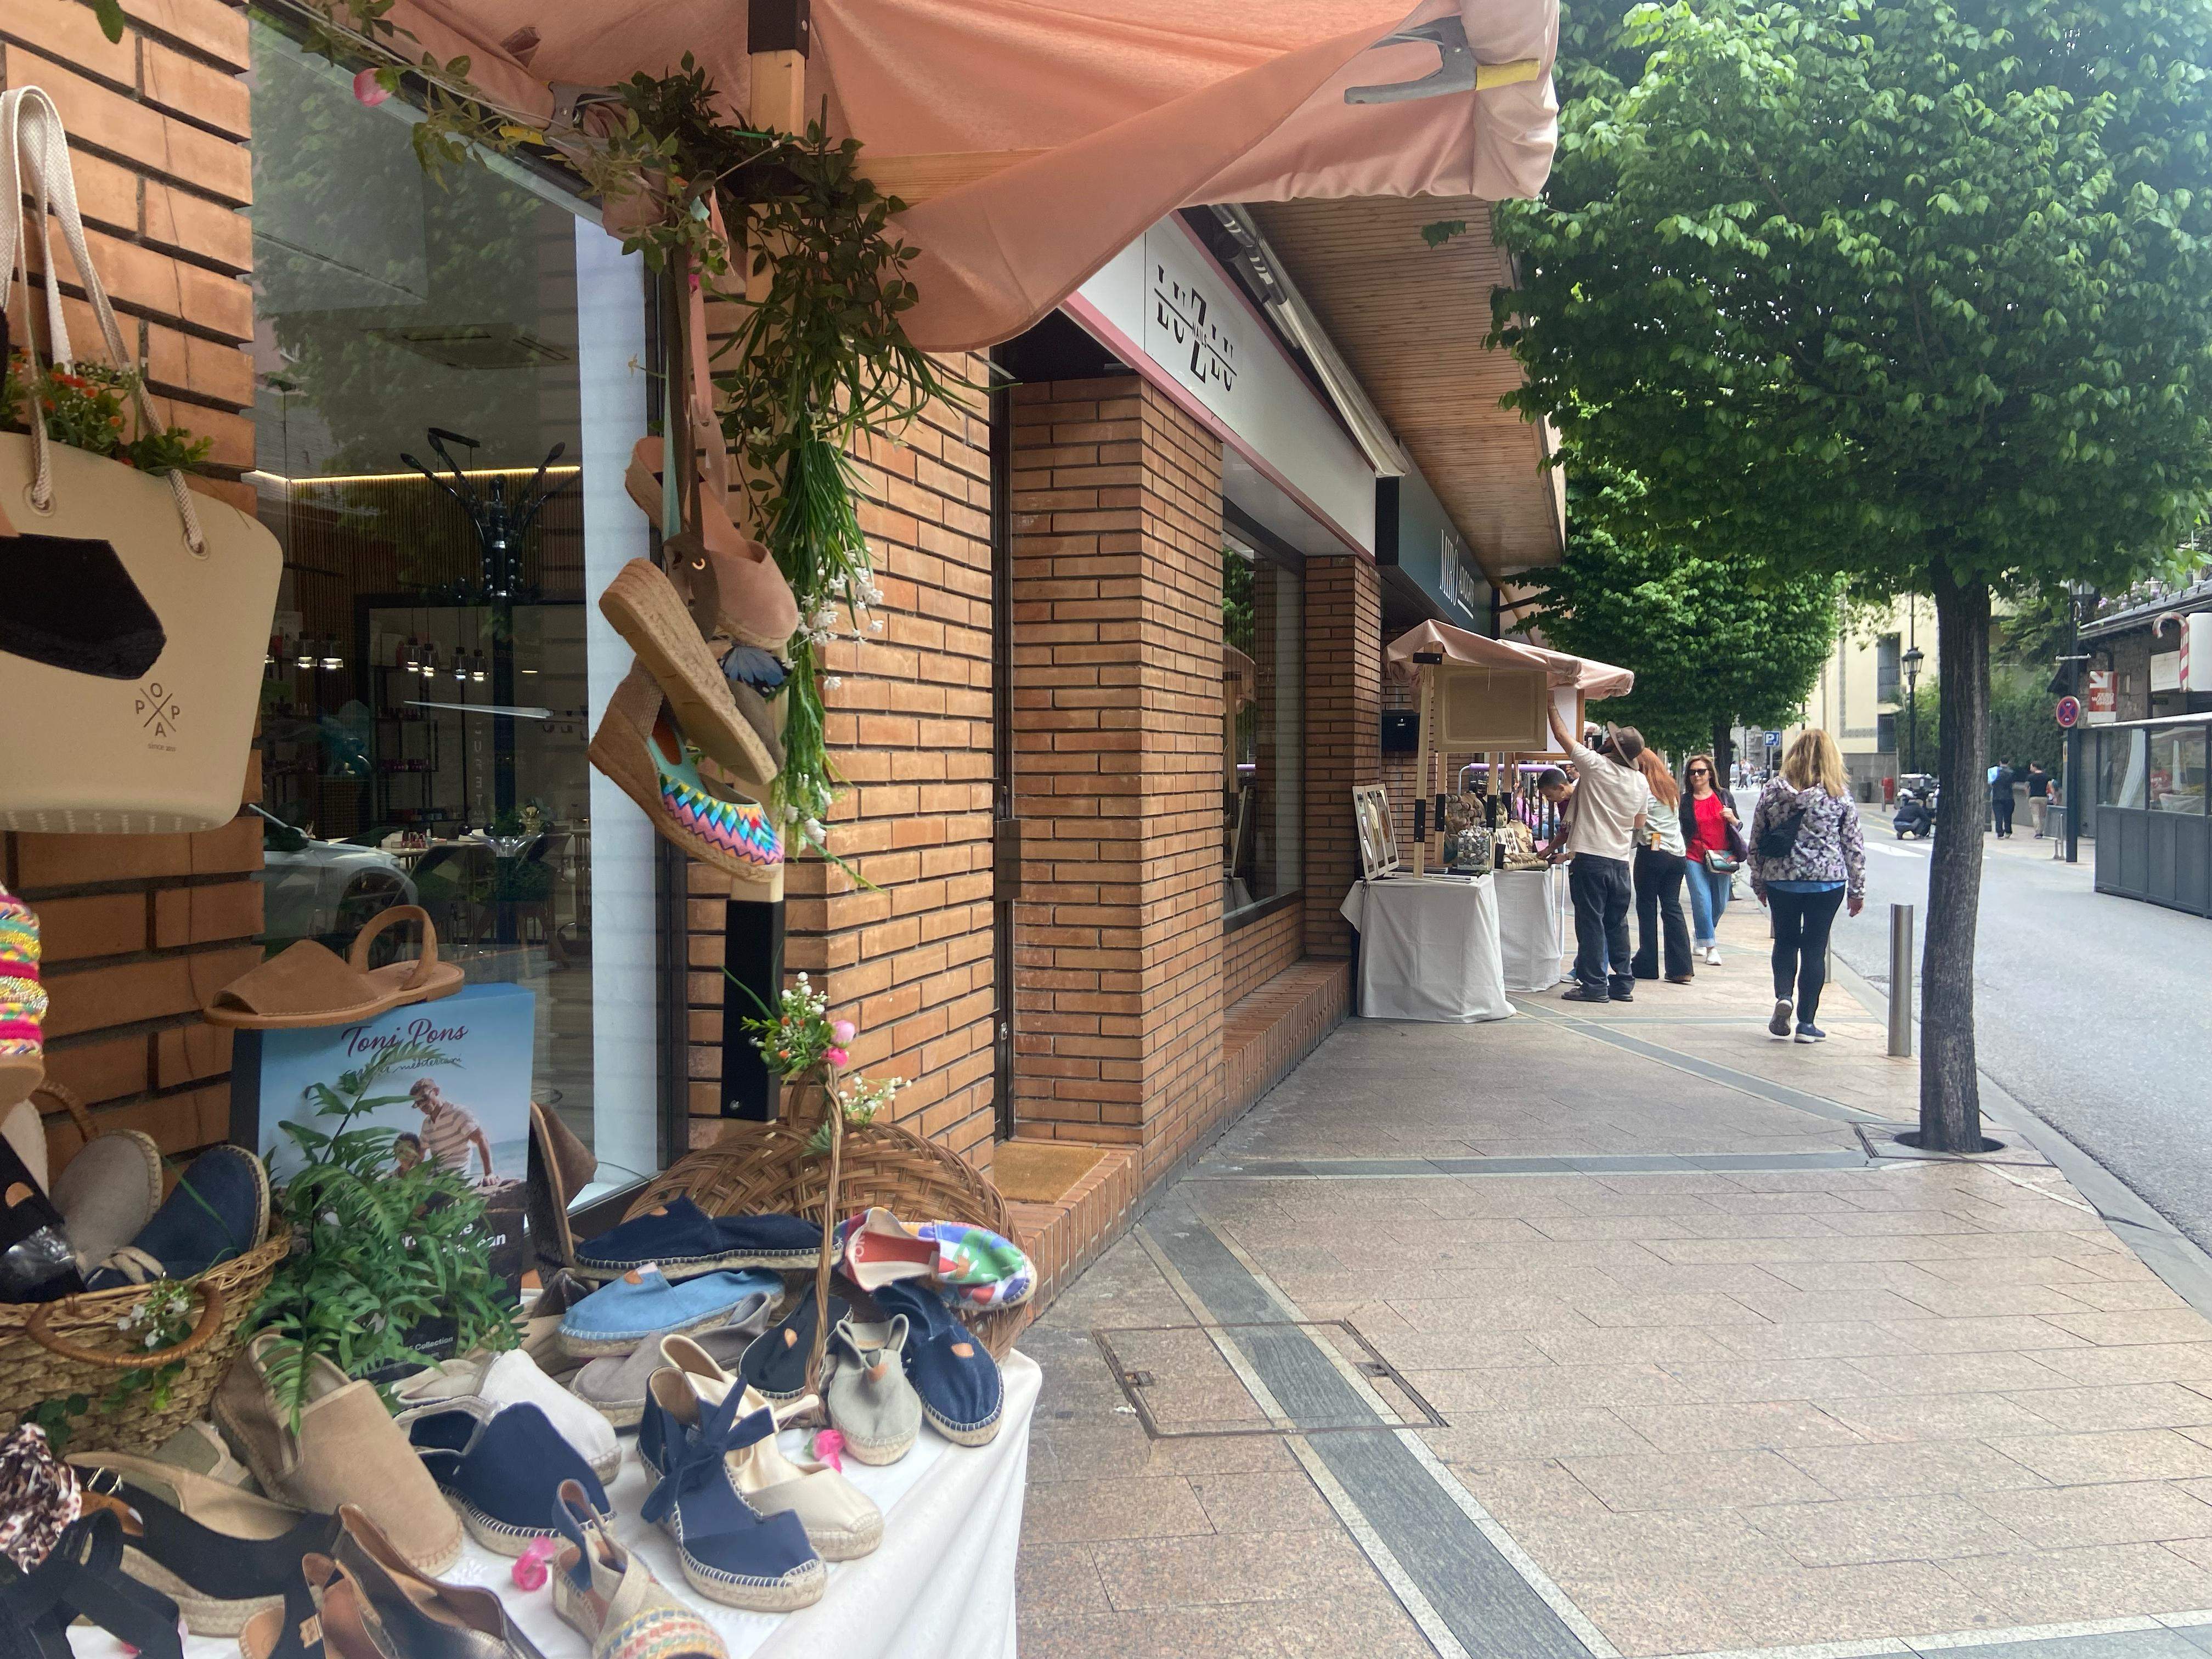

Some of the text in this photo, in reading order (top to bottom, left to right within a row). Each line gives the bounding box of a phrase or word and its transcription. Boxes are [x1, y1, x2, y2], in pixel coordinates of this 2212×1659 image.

[1192, 321, 1207, 348] NAILS
[1765, 733, 1775, 744] P
[341, 1018, 469, 1057] Toni Pons
[415, 1336, 454, 1351] Collection
